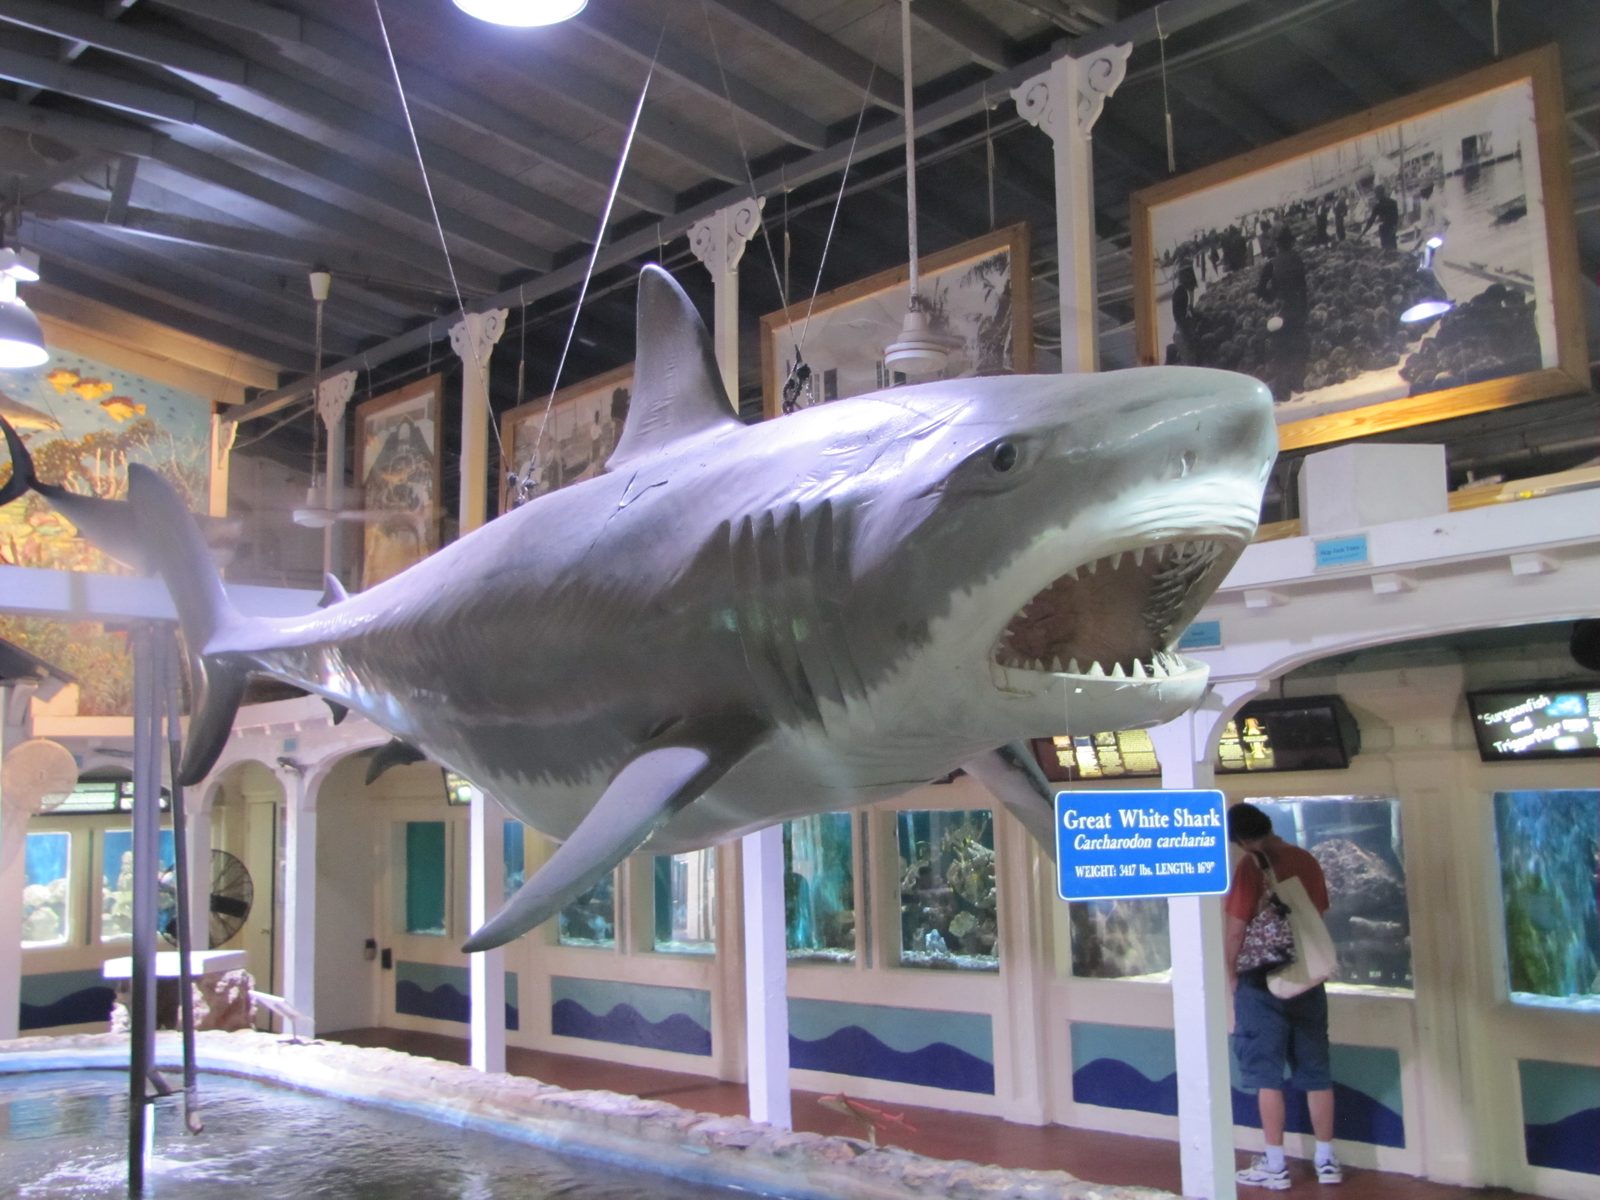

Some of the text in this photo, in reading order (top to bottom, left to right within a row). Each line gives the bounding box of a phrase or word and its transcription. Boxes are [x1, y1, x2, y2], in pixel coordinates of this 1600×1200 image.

[1483, 694, 1551, 725] Surgeonfish
[1063, 808, 1221, 830] Great White Shark
[1074, 831, 1216, 850] Carcharodon carcharias
[1075, 864, 1117, 878] WEIGHT:
[1119, 863, 1136, 877] 3417
[1139, 863, 1153, 876] lbs.
[1155, 862, 1195, 876] LENGTH:
